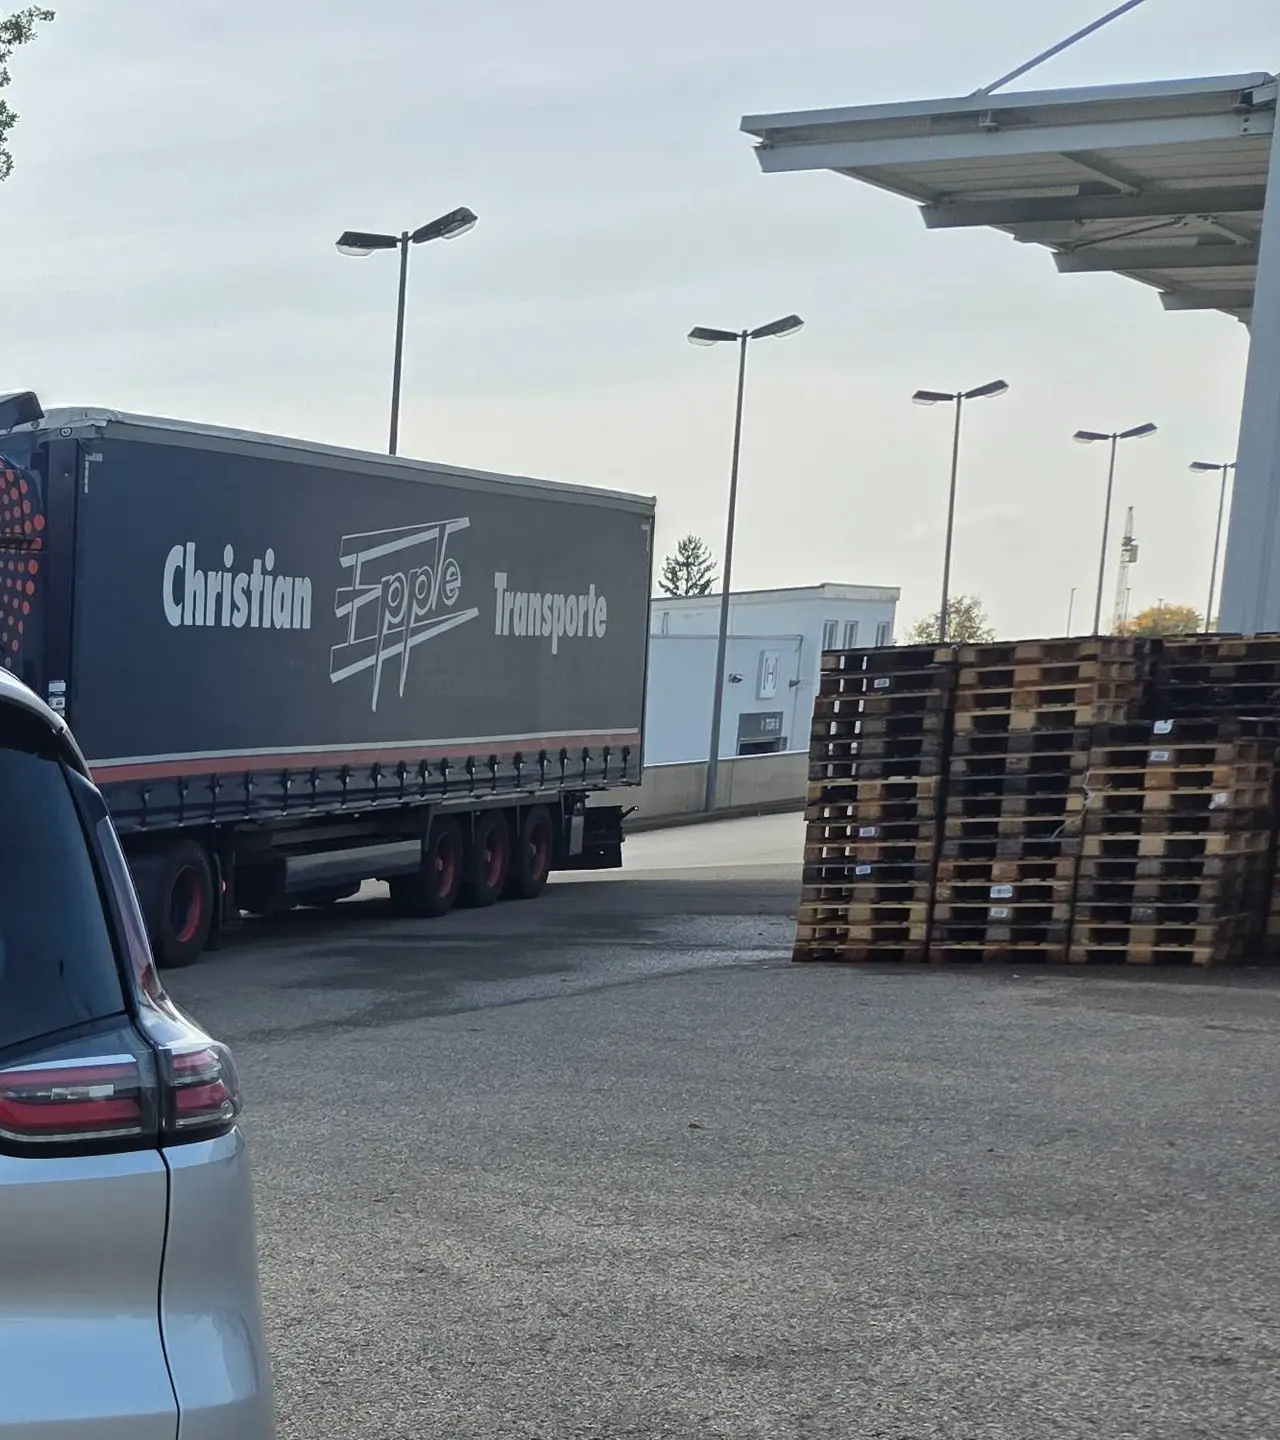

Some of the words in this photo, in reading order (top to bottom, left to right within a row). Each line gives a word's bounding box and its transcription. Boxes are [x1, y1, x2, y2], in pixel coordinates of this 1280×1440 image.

[162, 541, 313, 630] Christian
[329, 516, 480, 713] Epple
[494, 571, 608, 655] Transporte
